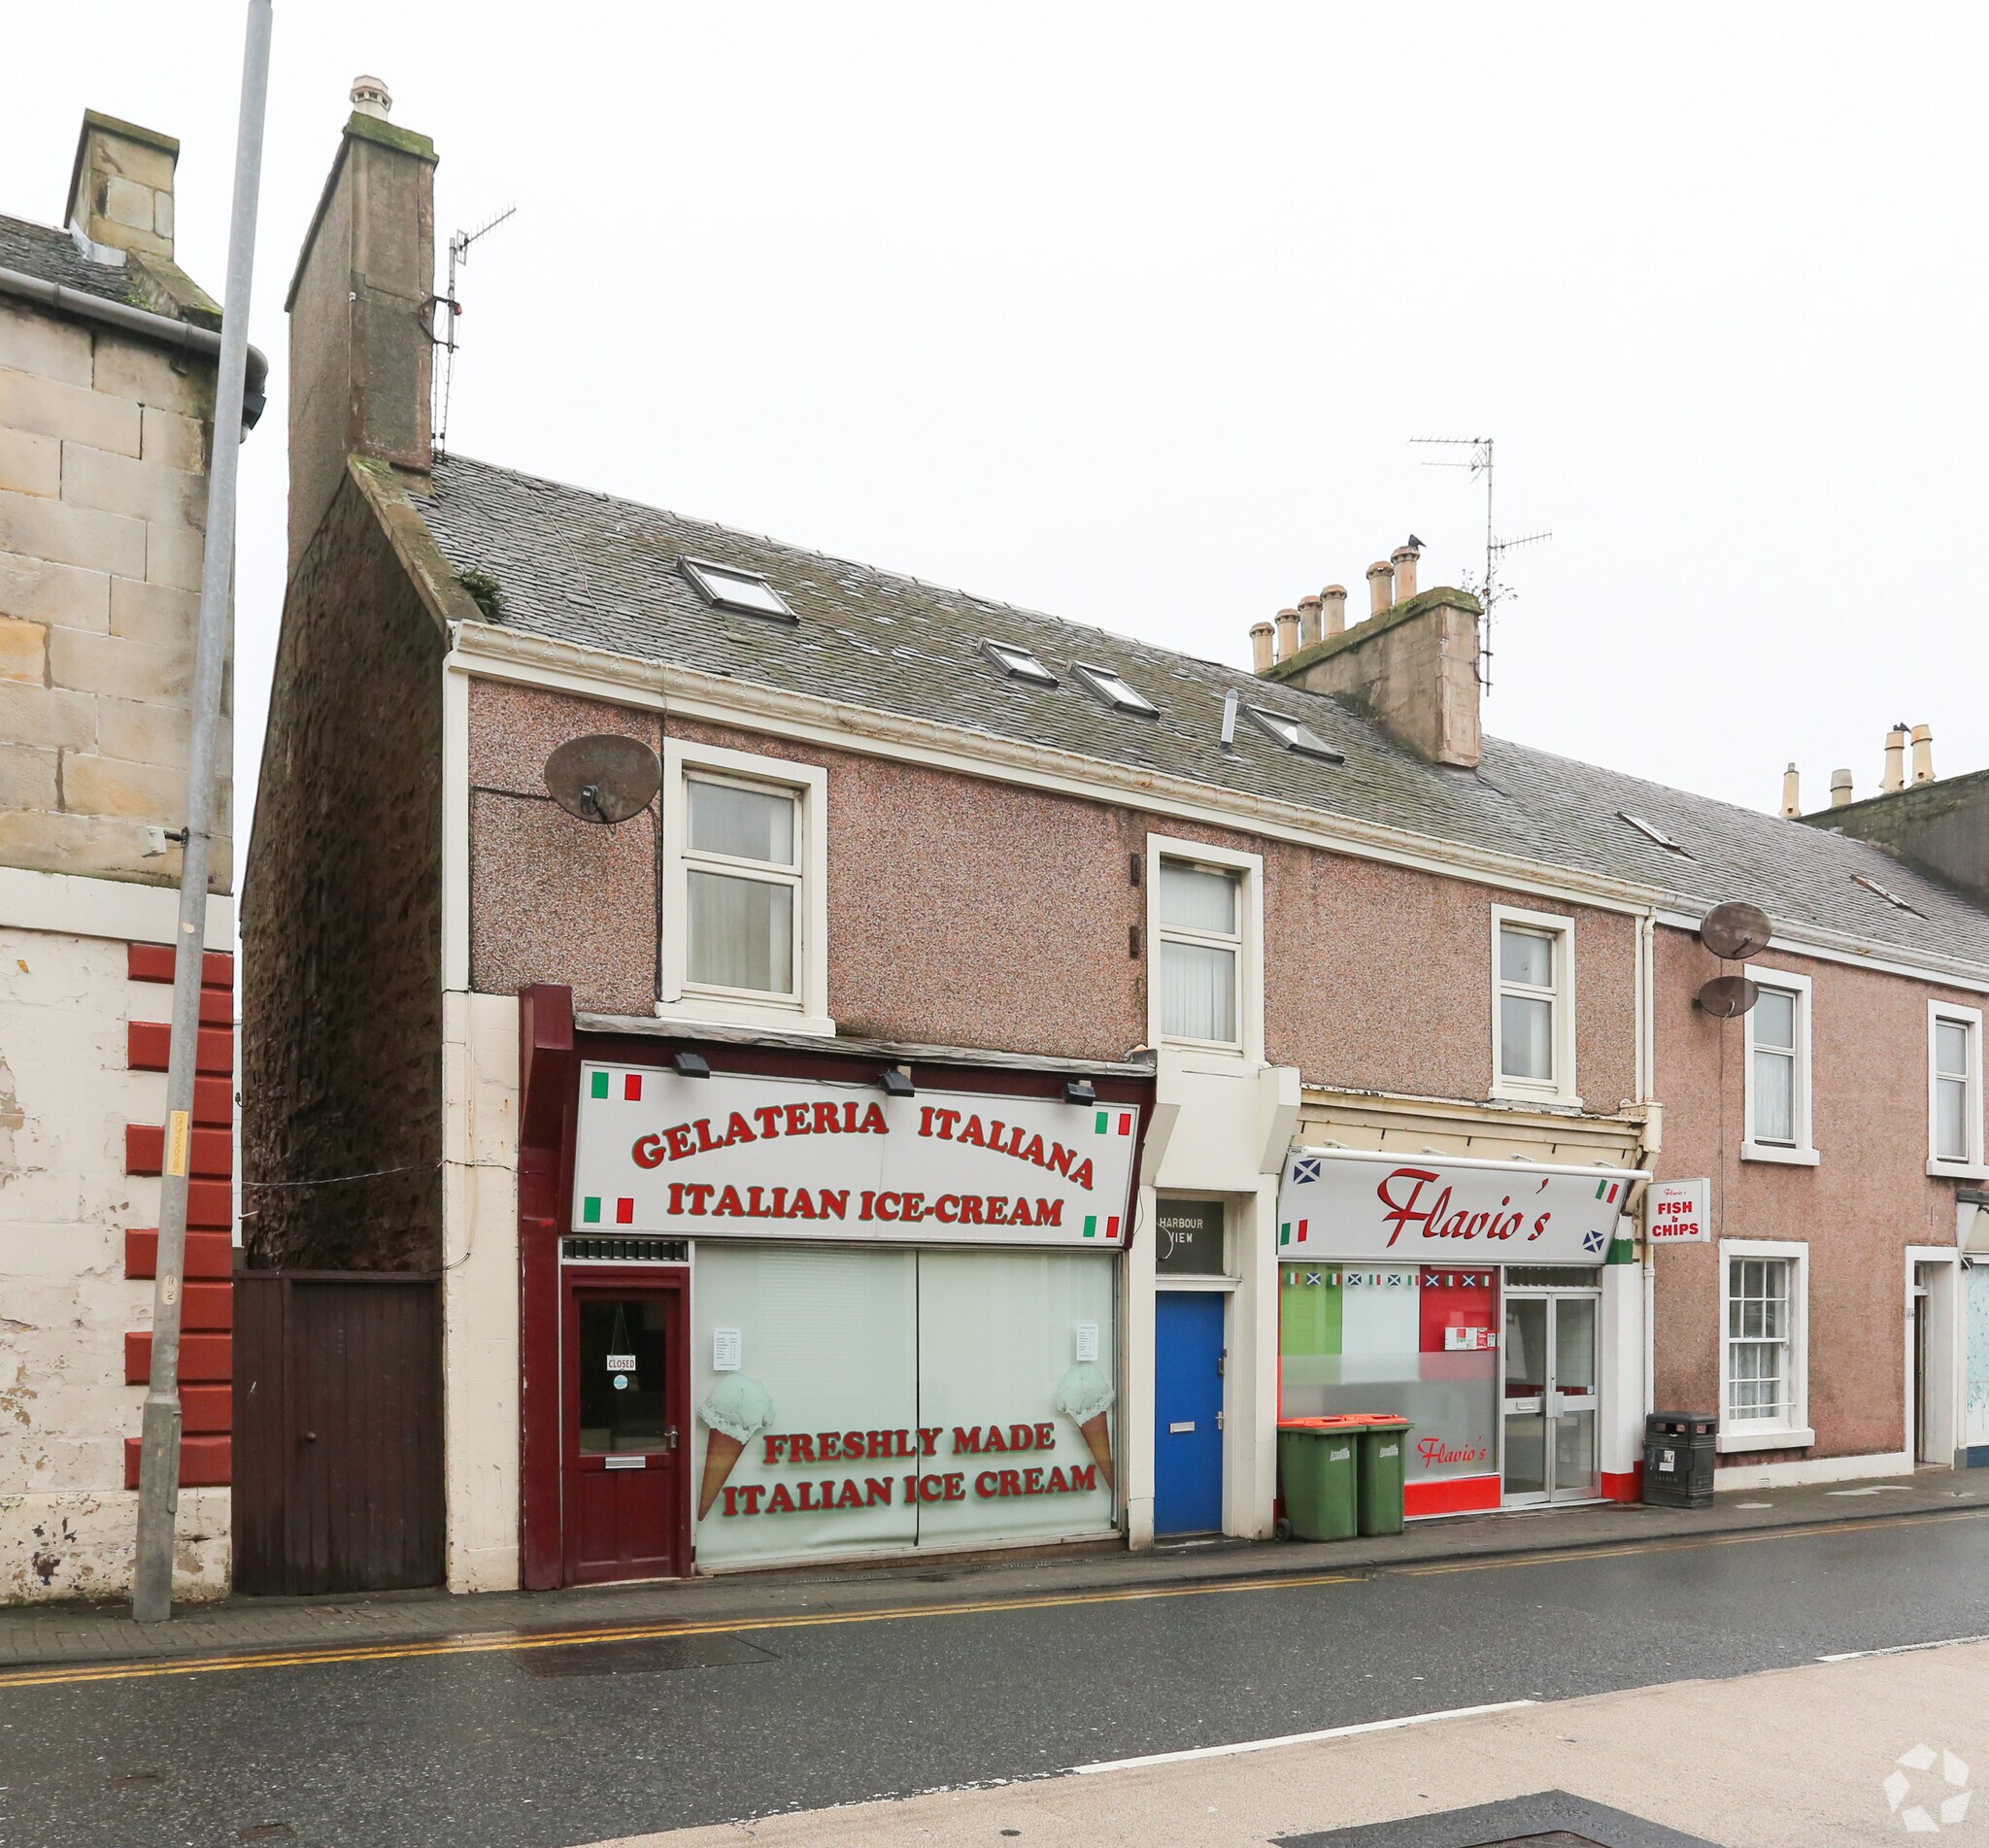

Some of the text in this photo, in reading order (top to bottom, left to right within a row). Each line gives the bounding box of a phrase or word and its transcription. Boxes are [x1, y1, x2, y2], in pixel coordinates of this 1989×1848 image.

[631, 1100, 1095, 1192] GELATERIA ITALIANA
[666, 1182, 1066, 1228] ITALIAN ICE-CREAM
[1376, 1167, 1551, 1249] Flavio's
[1658, 1201, 1693, 1215] FISH
[1160, 1218, 1203, 1229] HARBOUR
[1169, 1232, 1193, 1243] VIEW
[1652, 1223, 1699, 1237] CHIPS
[608, 1360, 635, 1368] CLOSED
[762, 1422, 1057, 1464] FRESHLY MADE
[1417, 1435, 1487, 1468] Flavio's
[722, 1463, 1097, 1517] ITALIAN ICE CREAM
